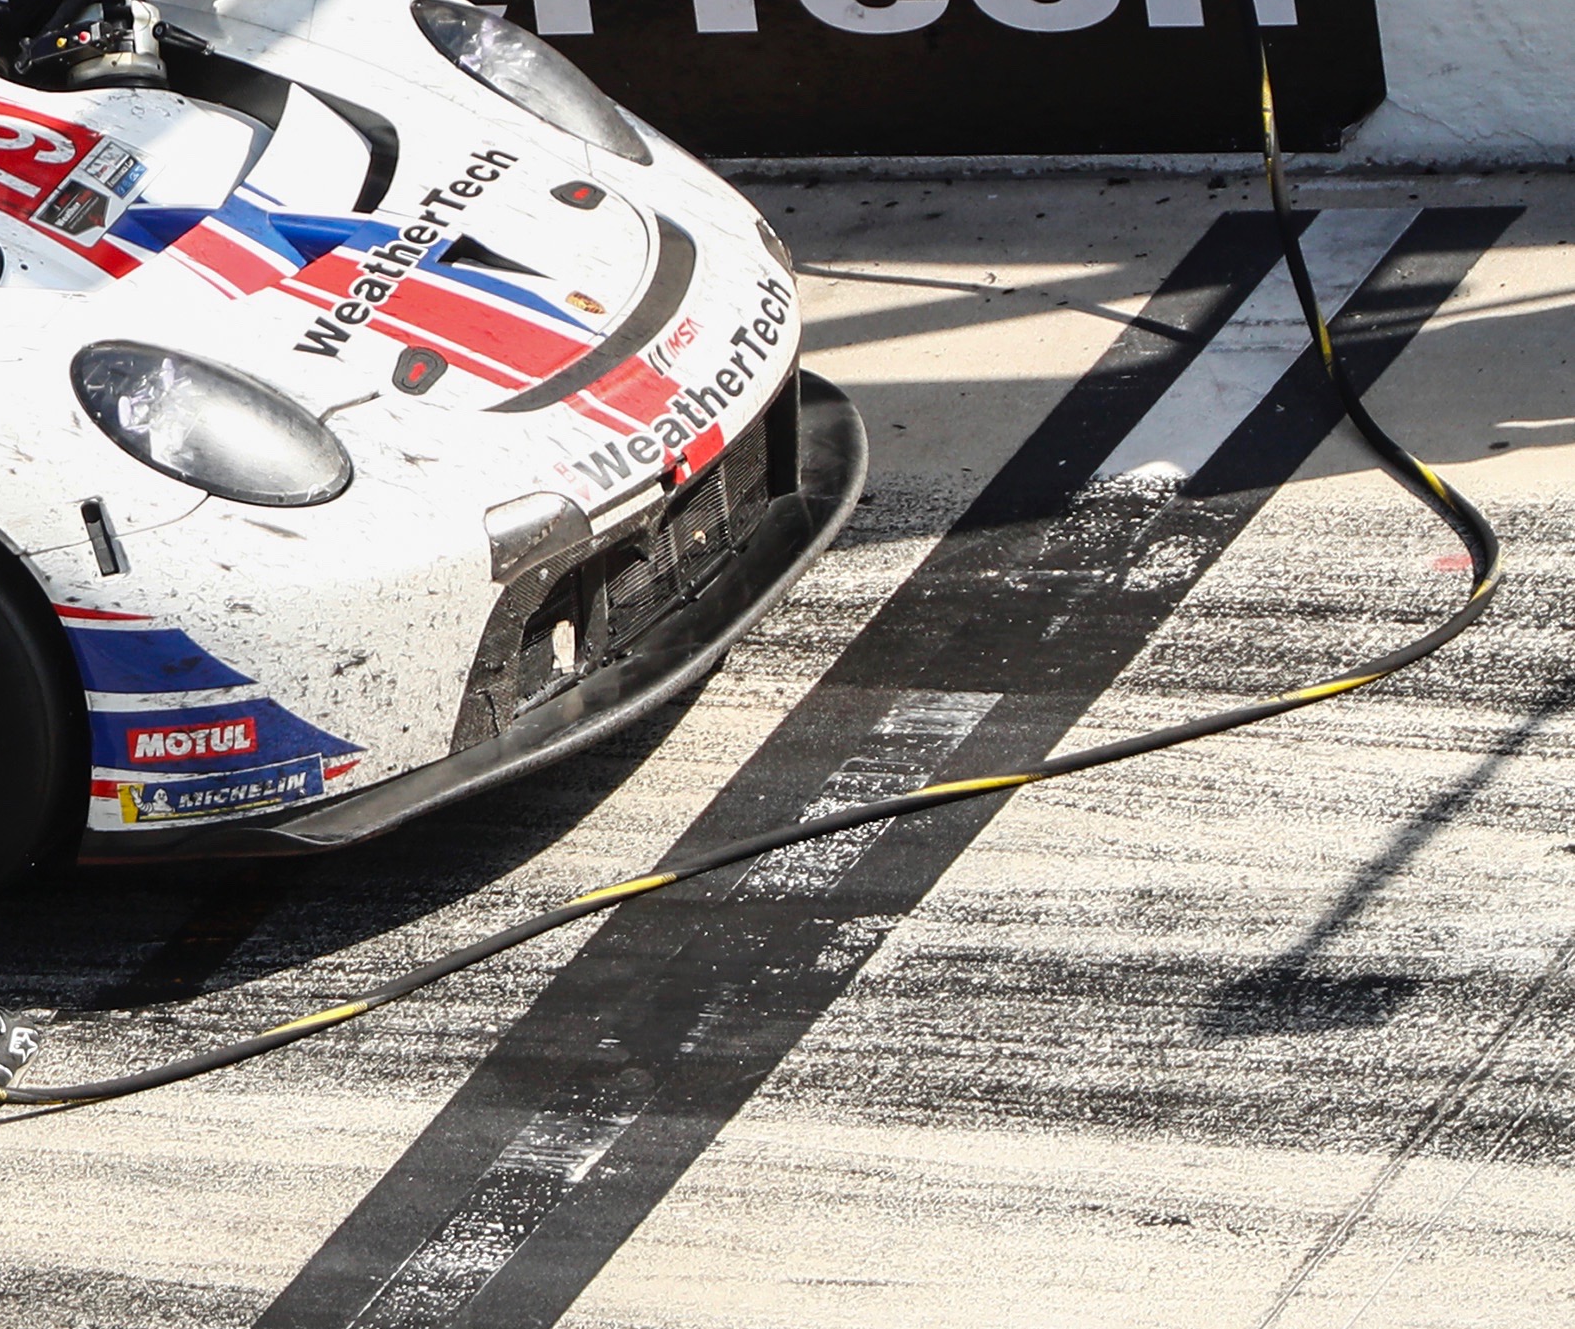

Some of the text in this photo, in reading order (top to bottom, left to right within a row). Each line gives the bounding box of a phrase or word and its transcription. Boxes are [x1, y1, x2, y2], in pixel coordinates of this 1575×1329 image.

[293, 145, 520, 358] WeatherTech
[572, 276, 793, 491] WeatherTech
[134, 723, 252, 759] MOTUL
[178, 771, 307, 809] MICHELIN
